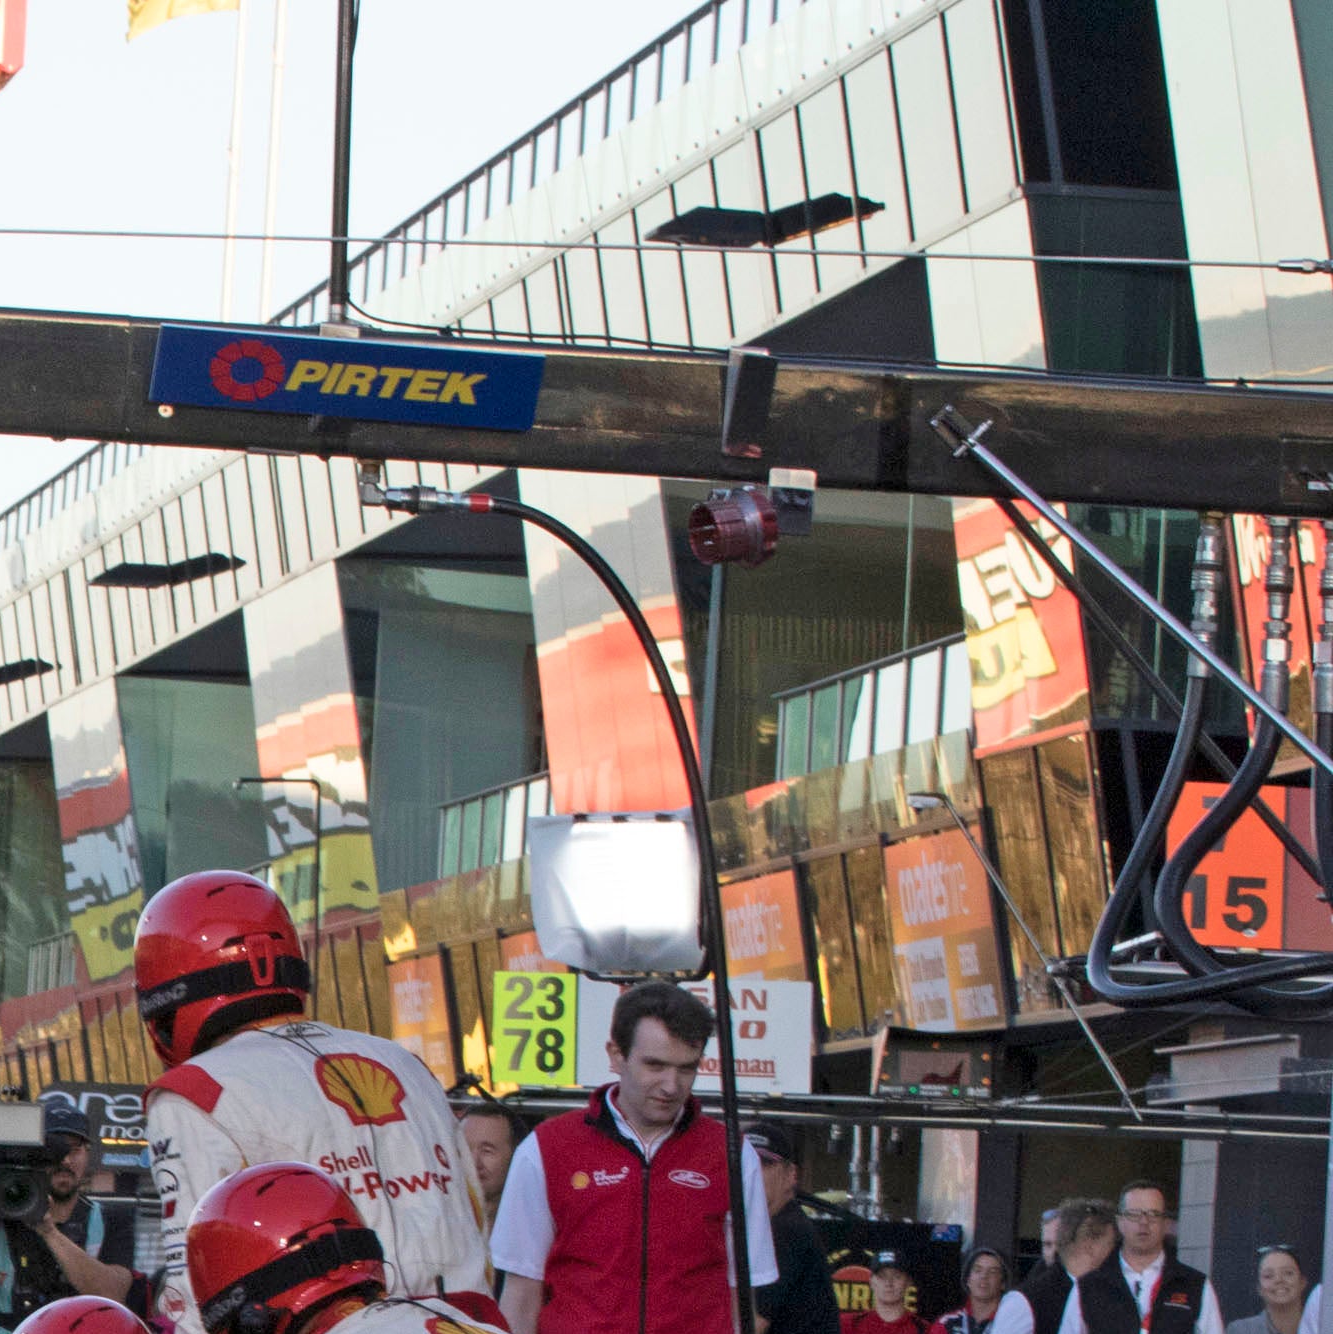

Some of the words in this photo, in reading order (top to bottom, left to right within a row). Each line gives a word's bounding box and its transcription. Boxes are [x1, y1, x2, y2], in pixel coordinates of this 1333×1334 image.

[287, 362, 482, 403] PIRTEK
[503, 976, 565, 1021] 23
[502, 1028, 565, 1073] 78
[318, 1145, 374, 1176] Shell
